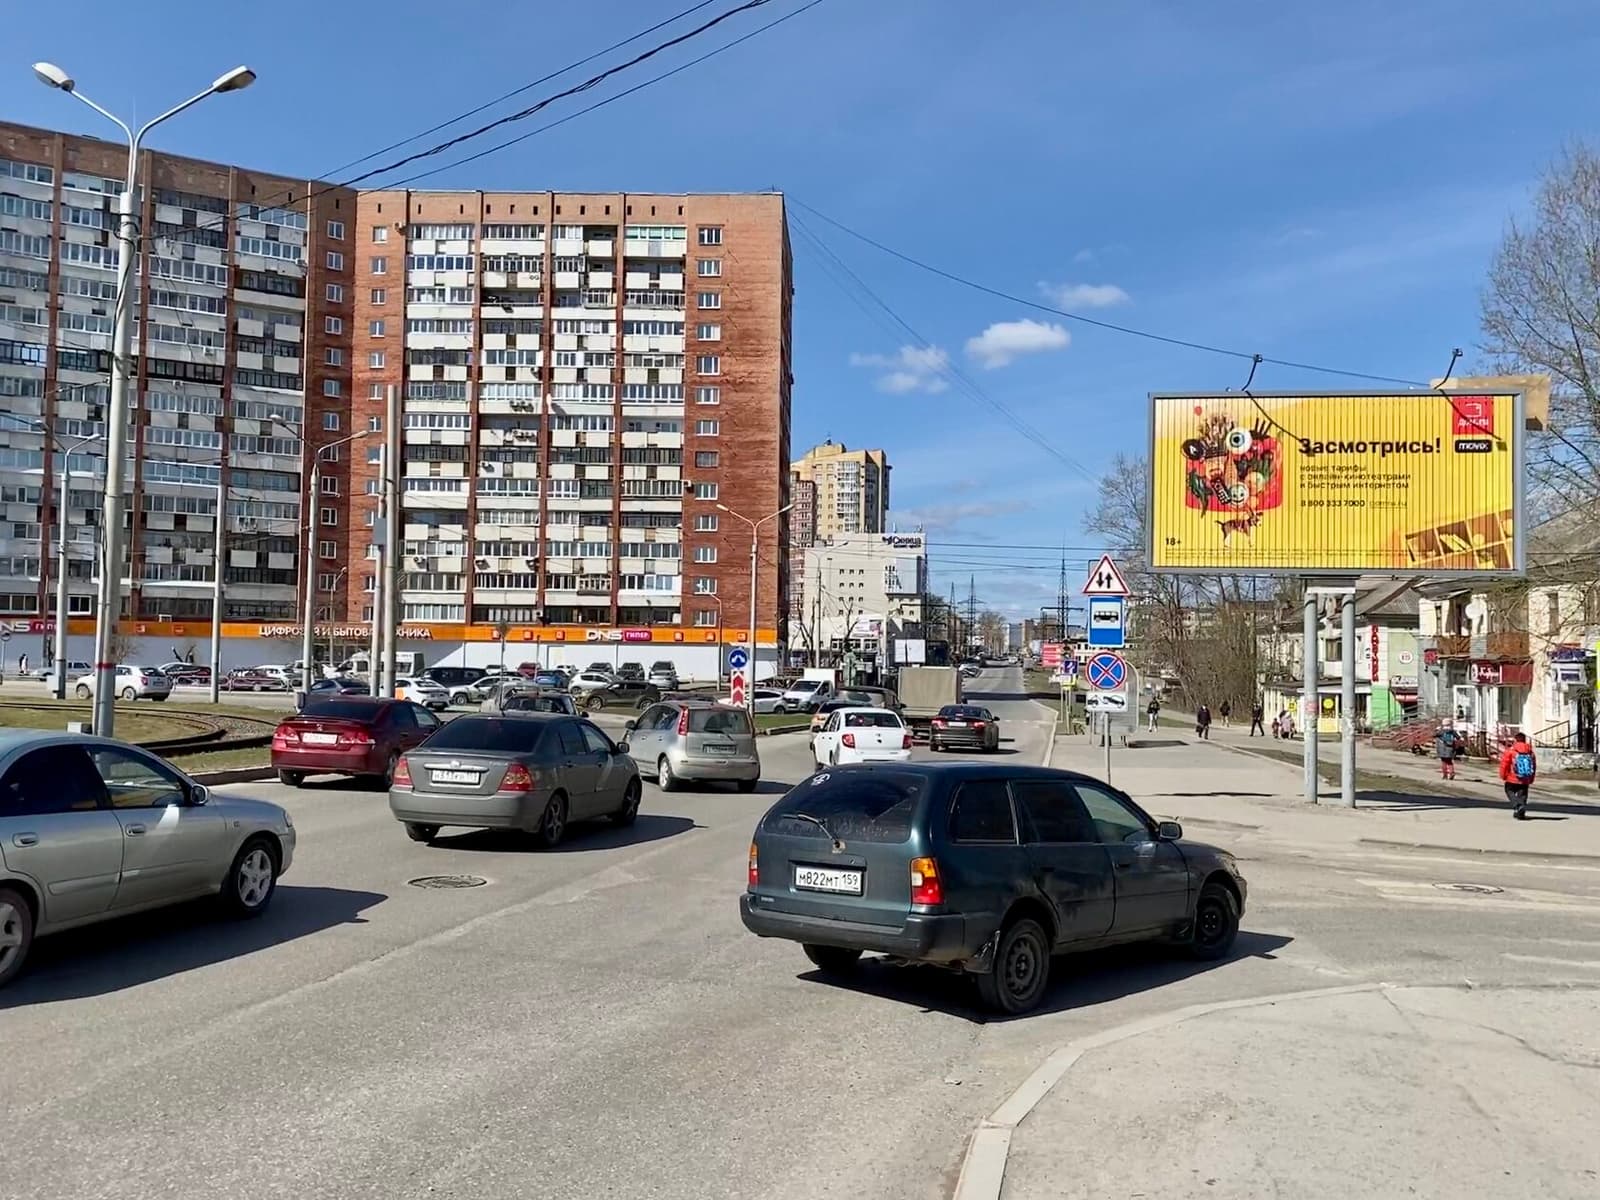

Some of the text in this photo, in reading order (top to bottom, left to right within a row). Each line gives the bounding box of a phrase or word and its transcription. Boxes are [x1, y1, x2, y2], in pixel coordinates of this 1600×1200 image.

[1299, 438, 1441, 458] Засмотрись!
[1165, 537, 1182, 546] 18+
[587, 629, 623, 641] DNS
[841, 873, 858, 886] 159
